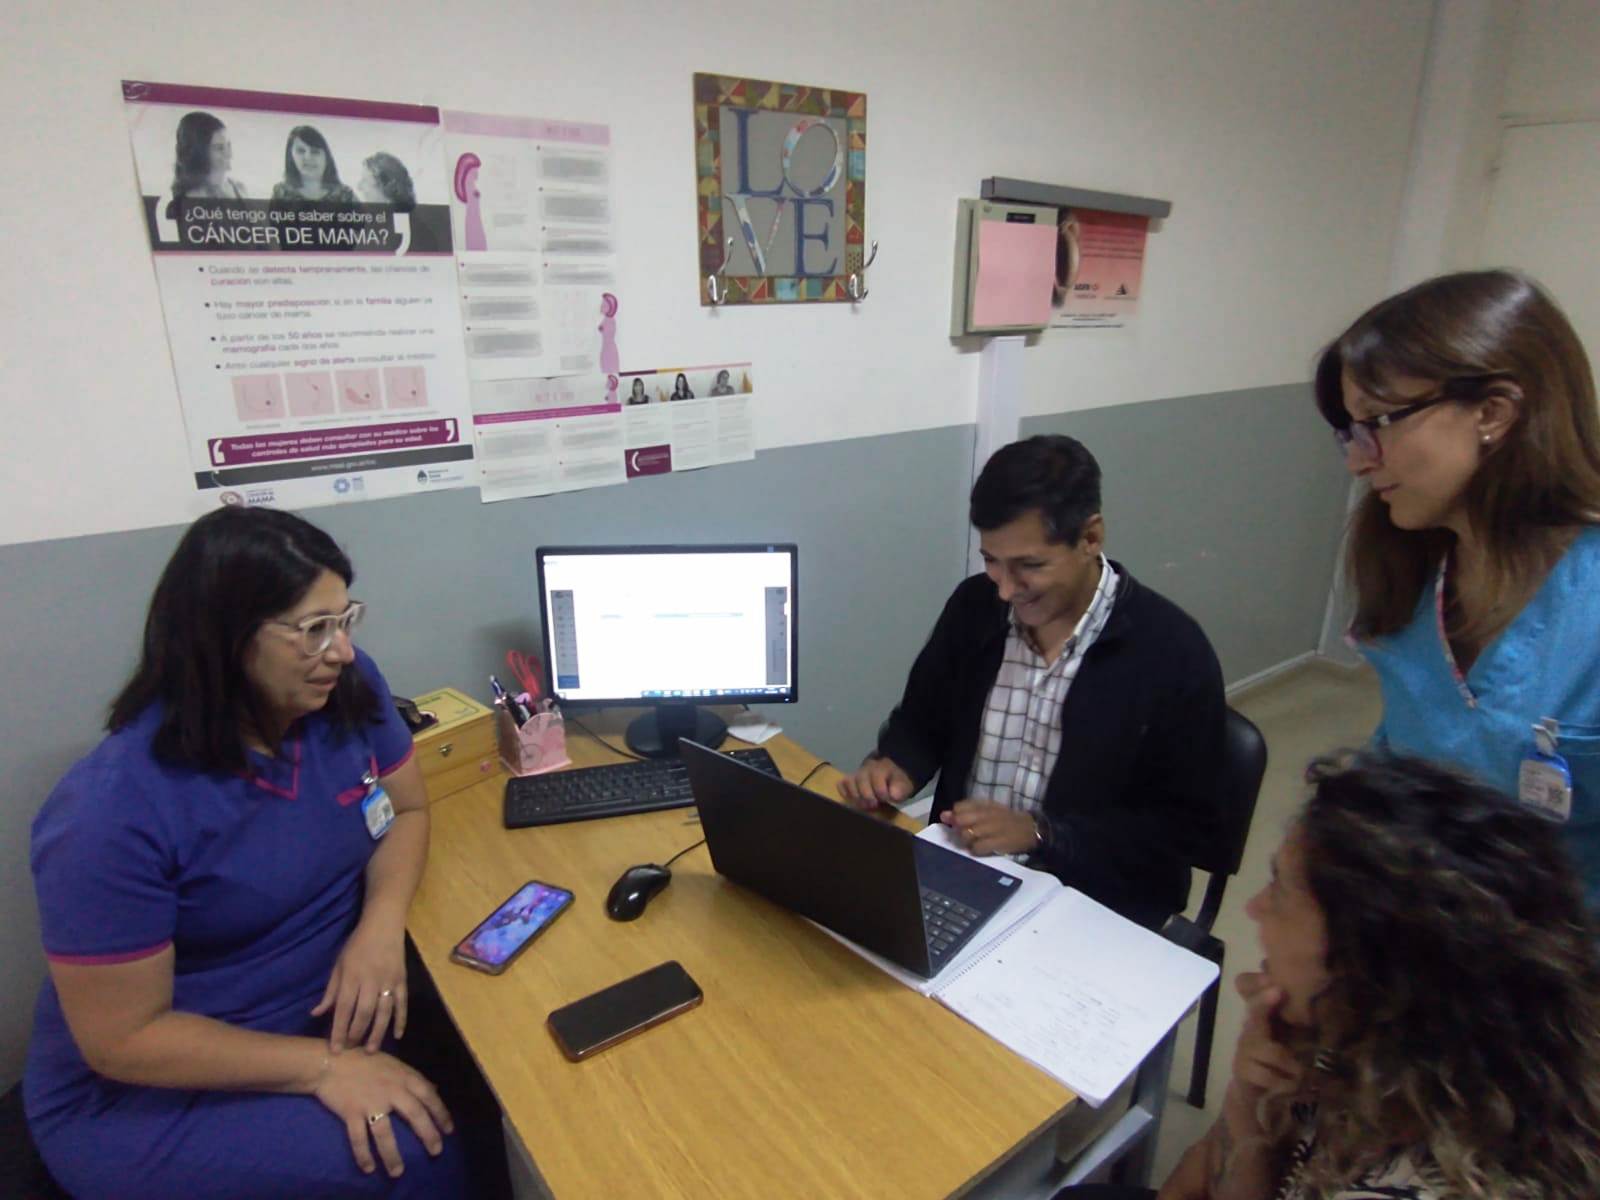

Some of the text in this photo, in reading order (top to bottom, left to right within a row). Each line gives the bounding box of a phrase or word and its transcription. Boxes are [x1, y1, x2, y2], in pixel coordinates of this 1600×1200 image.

[185, 206, 386, 224] ¿Qué tengo que saber sobre el
[187, 222, 389, 245] CÁNCER DE MAMA?
